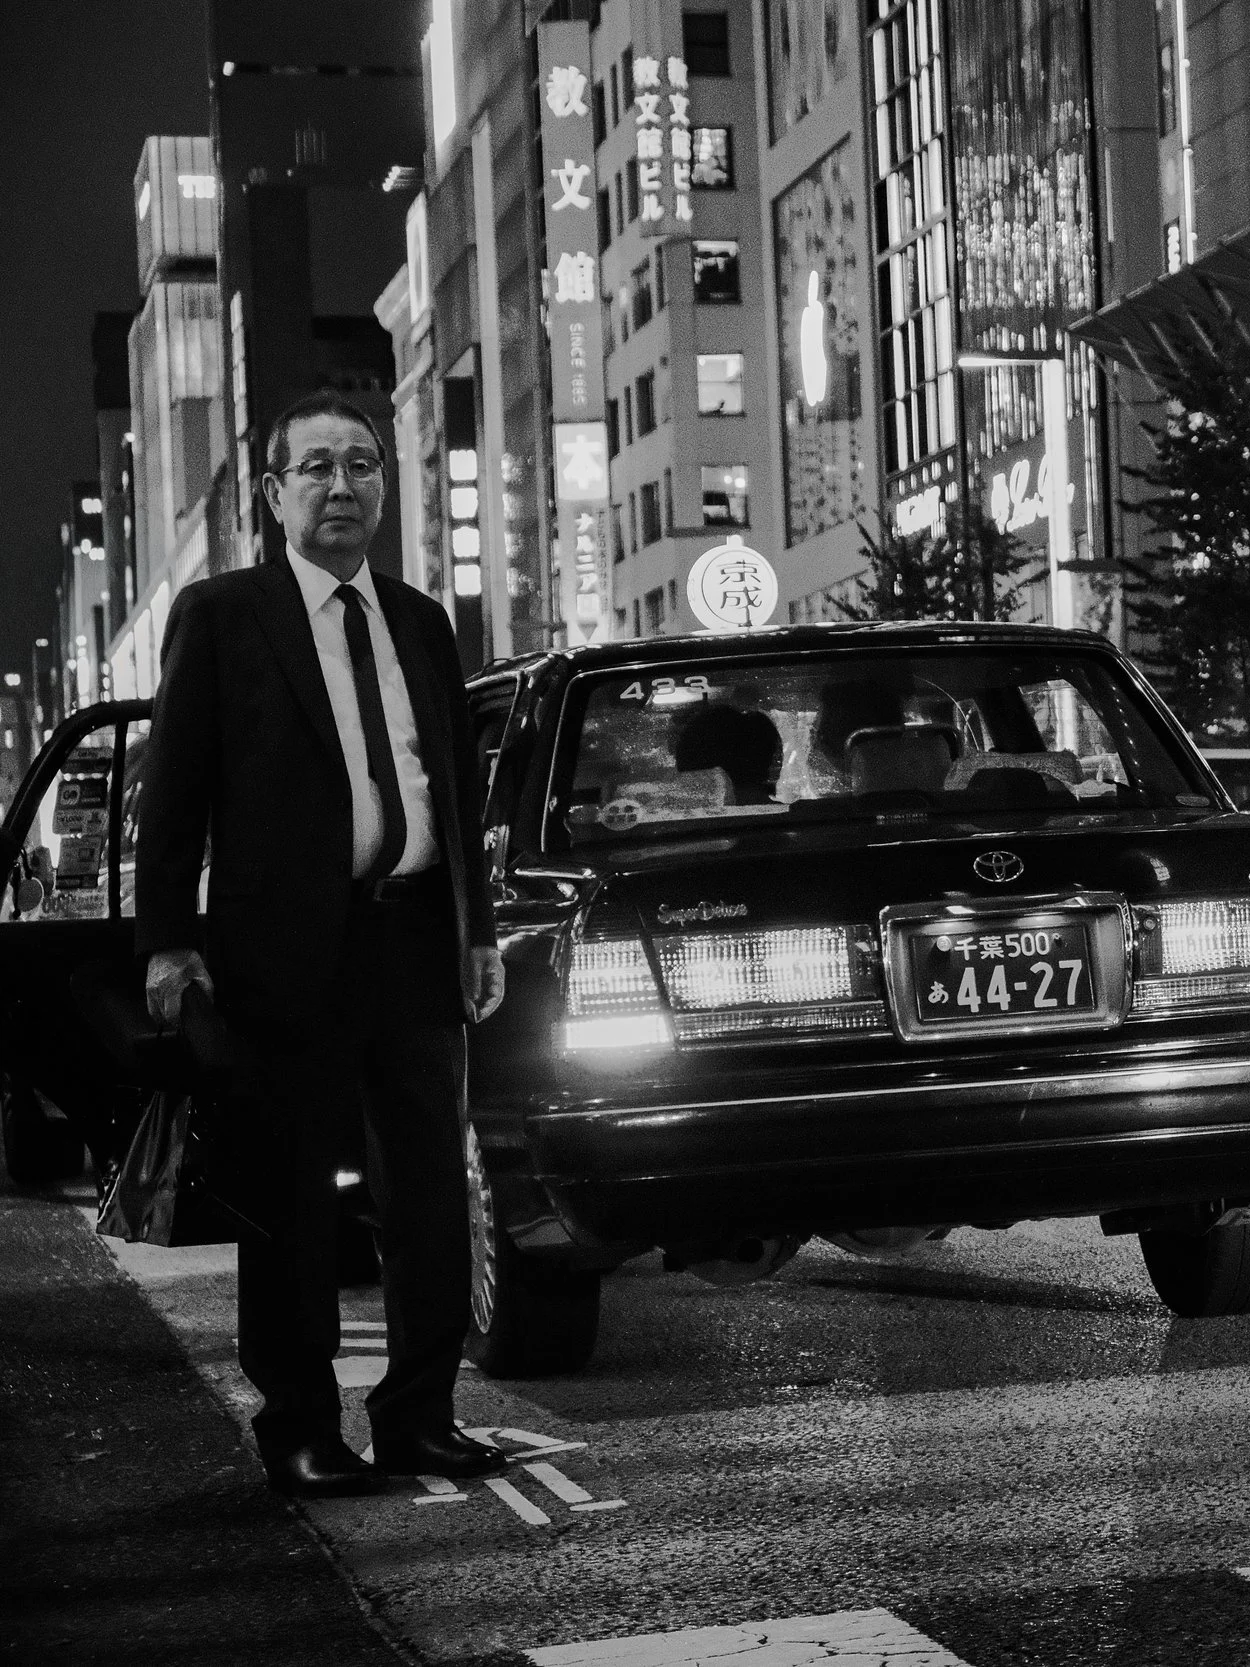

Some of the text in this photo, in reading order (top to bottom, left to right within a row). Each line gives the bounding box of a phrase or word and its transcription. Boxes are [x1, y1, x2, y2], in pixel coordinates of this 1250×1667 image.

[545, 65, 596, 304] 教文館
[569, 322, 586, 369] SINCE
[561, 434, 604, 490] 本
[717, 559, 763, 612] 京成
[928, 959, 1083, 1013] あ 44-27
